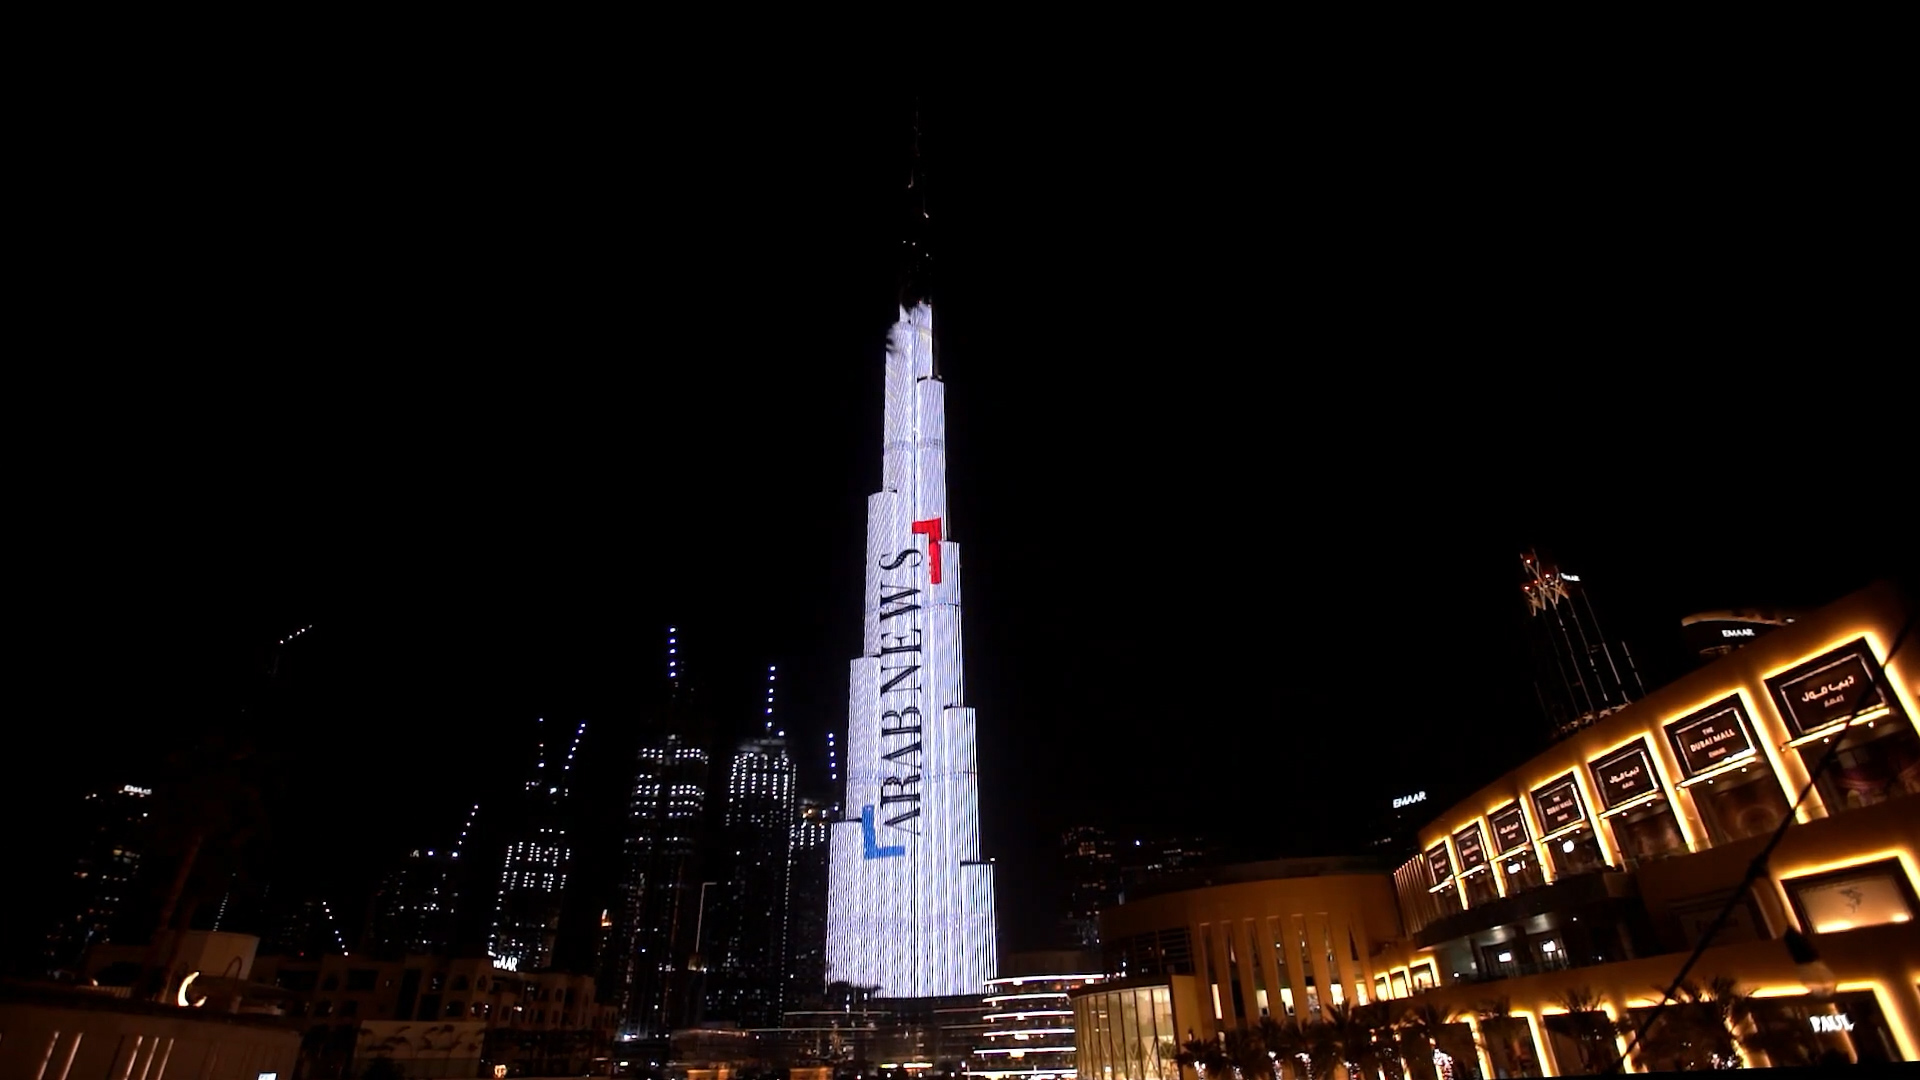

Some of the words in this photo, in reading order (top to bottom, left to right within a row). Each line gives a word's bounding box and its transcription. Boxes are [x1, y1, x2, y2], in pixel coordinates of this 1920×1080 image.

[1689, 737, 1714, 753] DUBAI
[1713, 728, 1736, 743] MALL
[1392, 790, 1427, 809] EMAAR
[1809, 1012, 1856, 1033] PAUL
